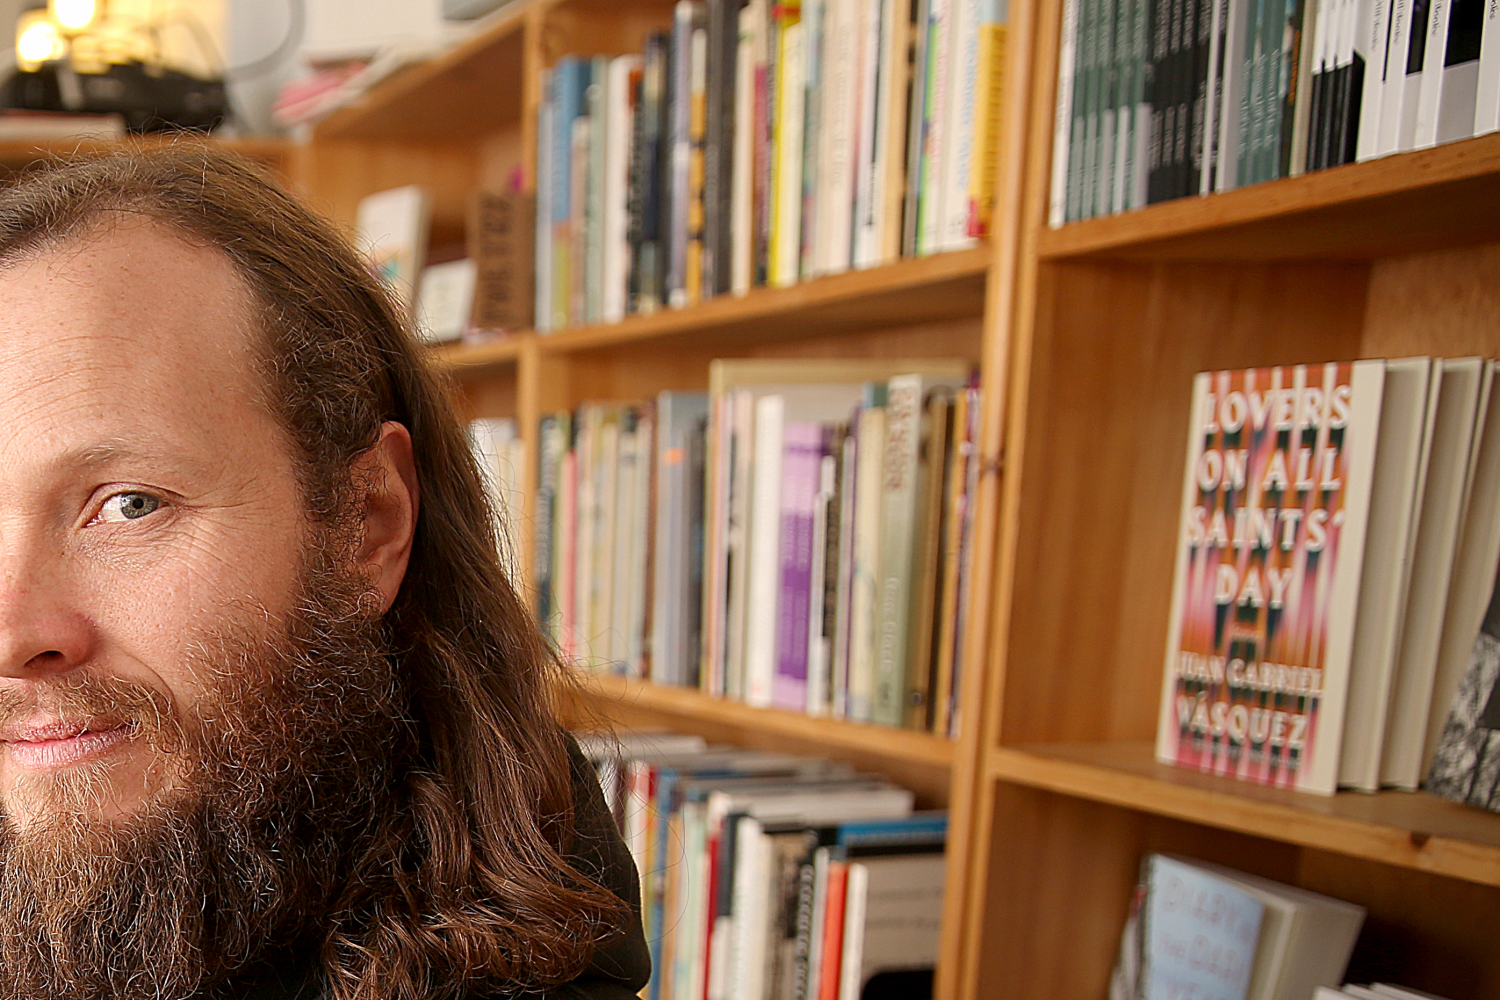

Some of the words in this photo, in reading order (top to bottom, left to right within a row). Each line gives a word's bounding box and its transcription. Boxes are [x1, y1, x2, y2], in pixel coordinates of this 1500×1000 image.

[1202, 384, 1352, 434] LOVERS
[1197, 449, 1249, 491] ON
[1263, 447, 1341, 491] ALL
[1214, 563, 1294, 607] DAY
[1174, 651, 1226, 687] JUAN
[1226, 658, 1325, 699] GABRIEL
[1175, 690, 1307, 748] VÁSQUEZ
